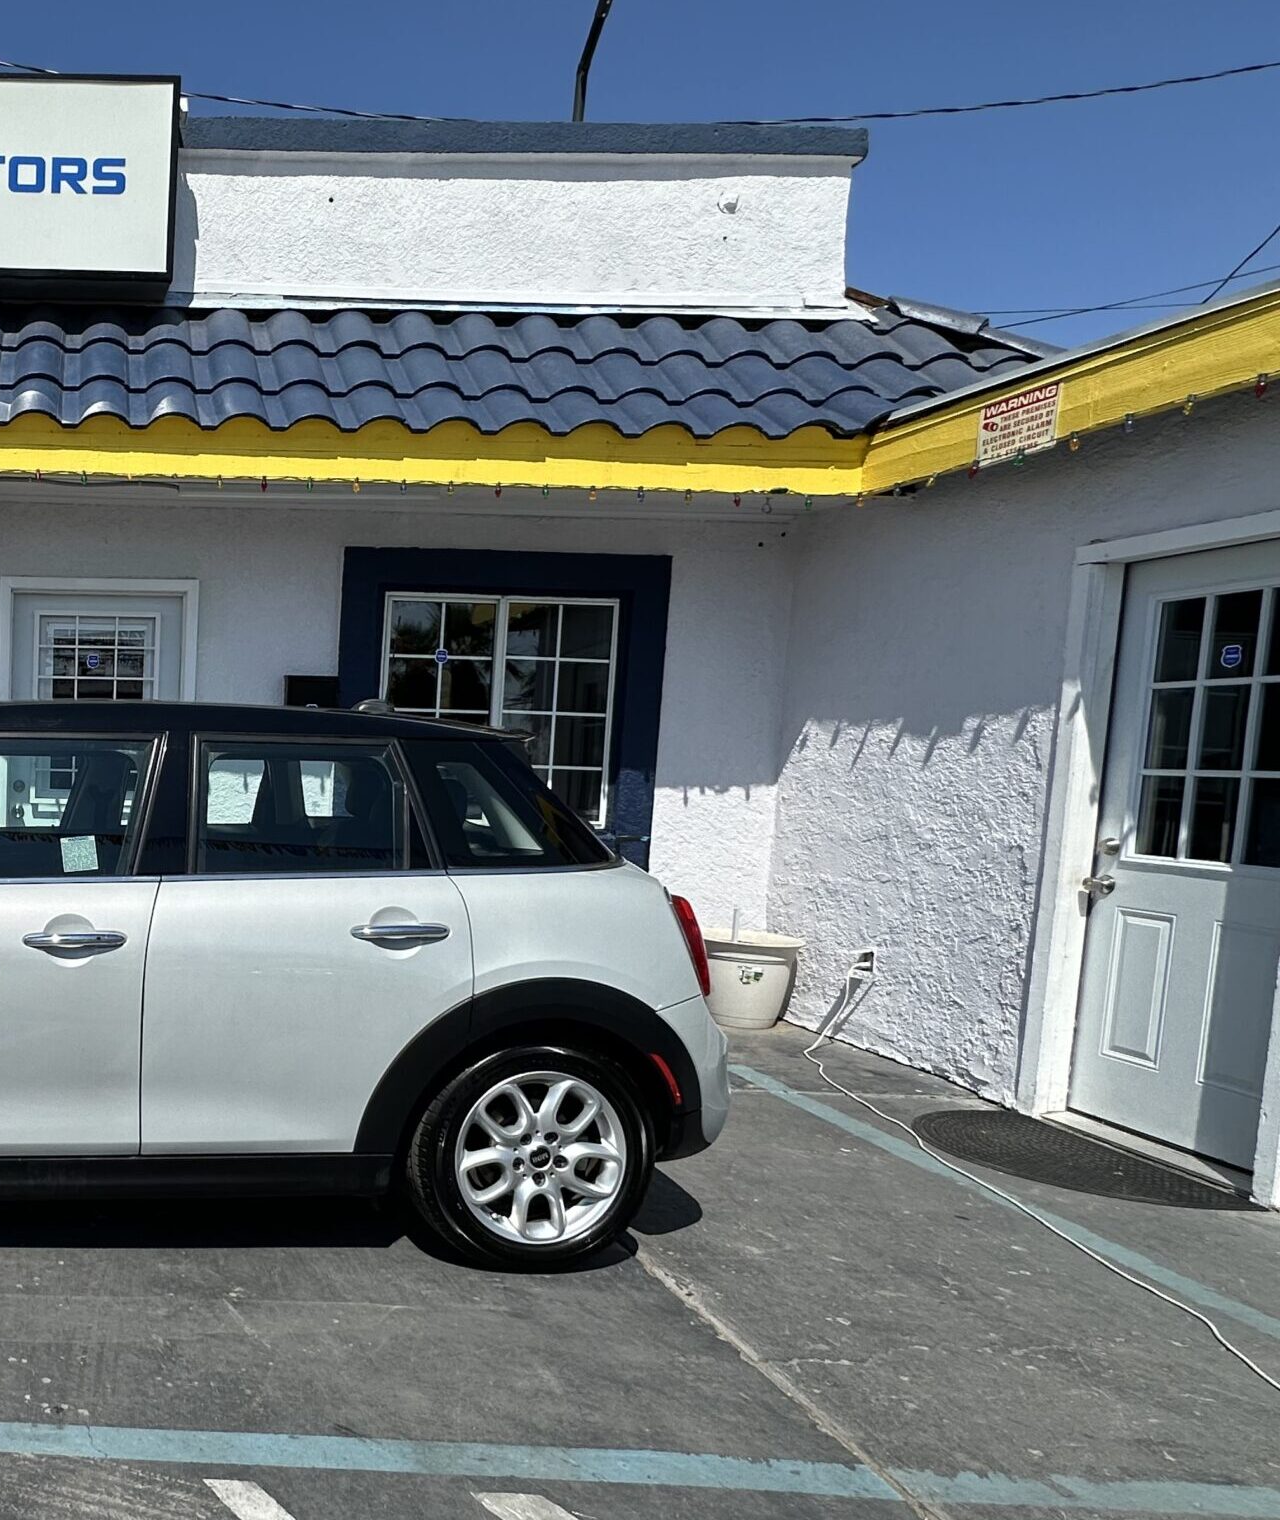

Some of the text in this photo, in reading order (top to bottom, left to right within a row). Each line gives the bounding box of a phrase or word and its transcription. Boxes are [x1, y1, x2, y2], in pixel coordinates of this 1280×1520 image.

[985, 385, 1058, 417] WARNING
[1000, 400, 1056, 422] THESE PREMISES
[982, 418, 1052, 447] ELECTRONIC ALARM
[999, 409, 1054, 432] ARE SECURED BY
[990, 439, 1016, 453] CLOSED
[1018, 428, 1050, 443] CIRCUIT
